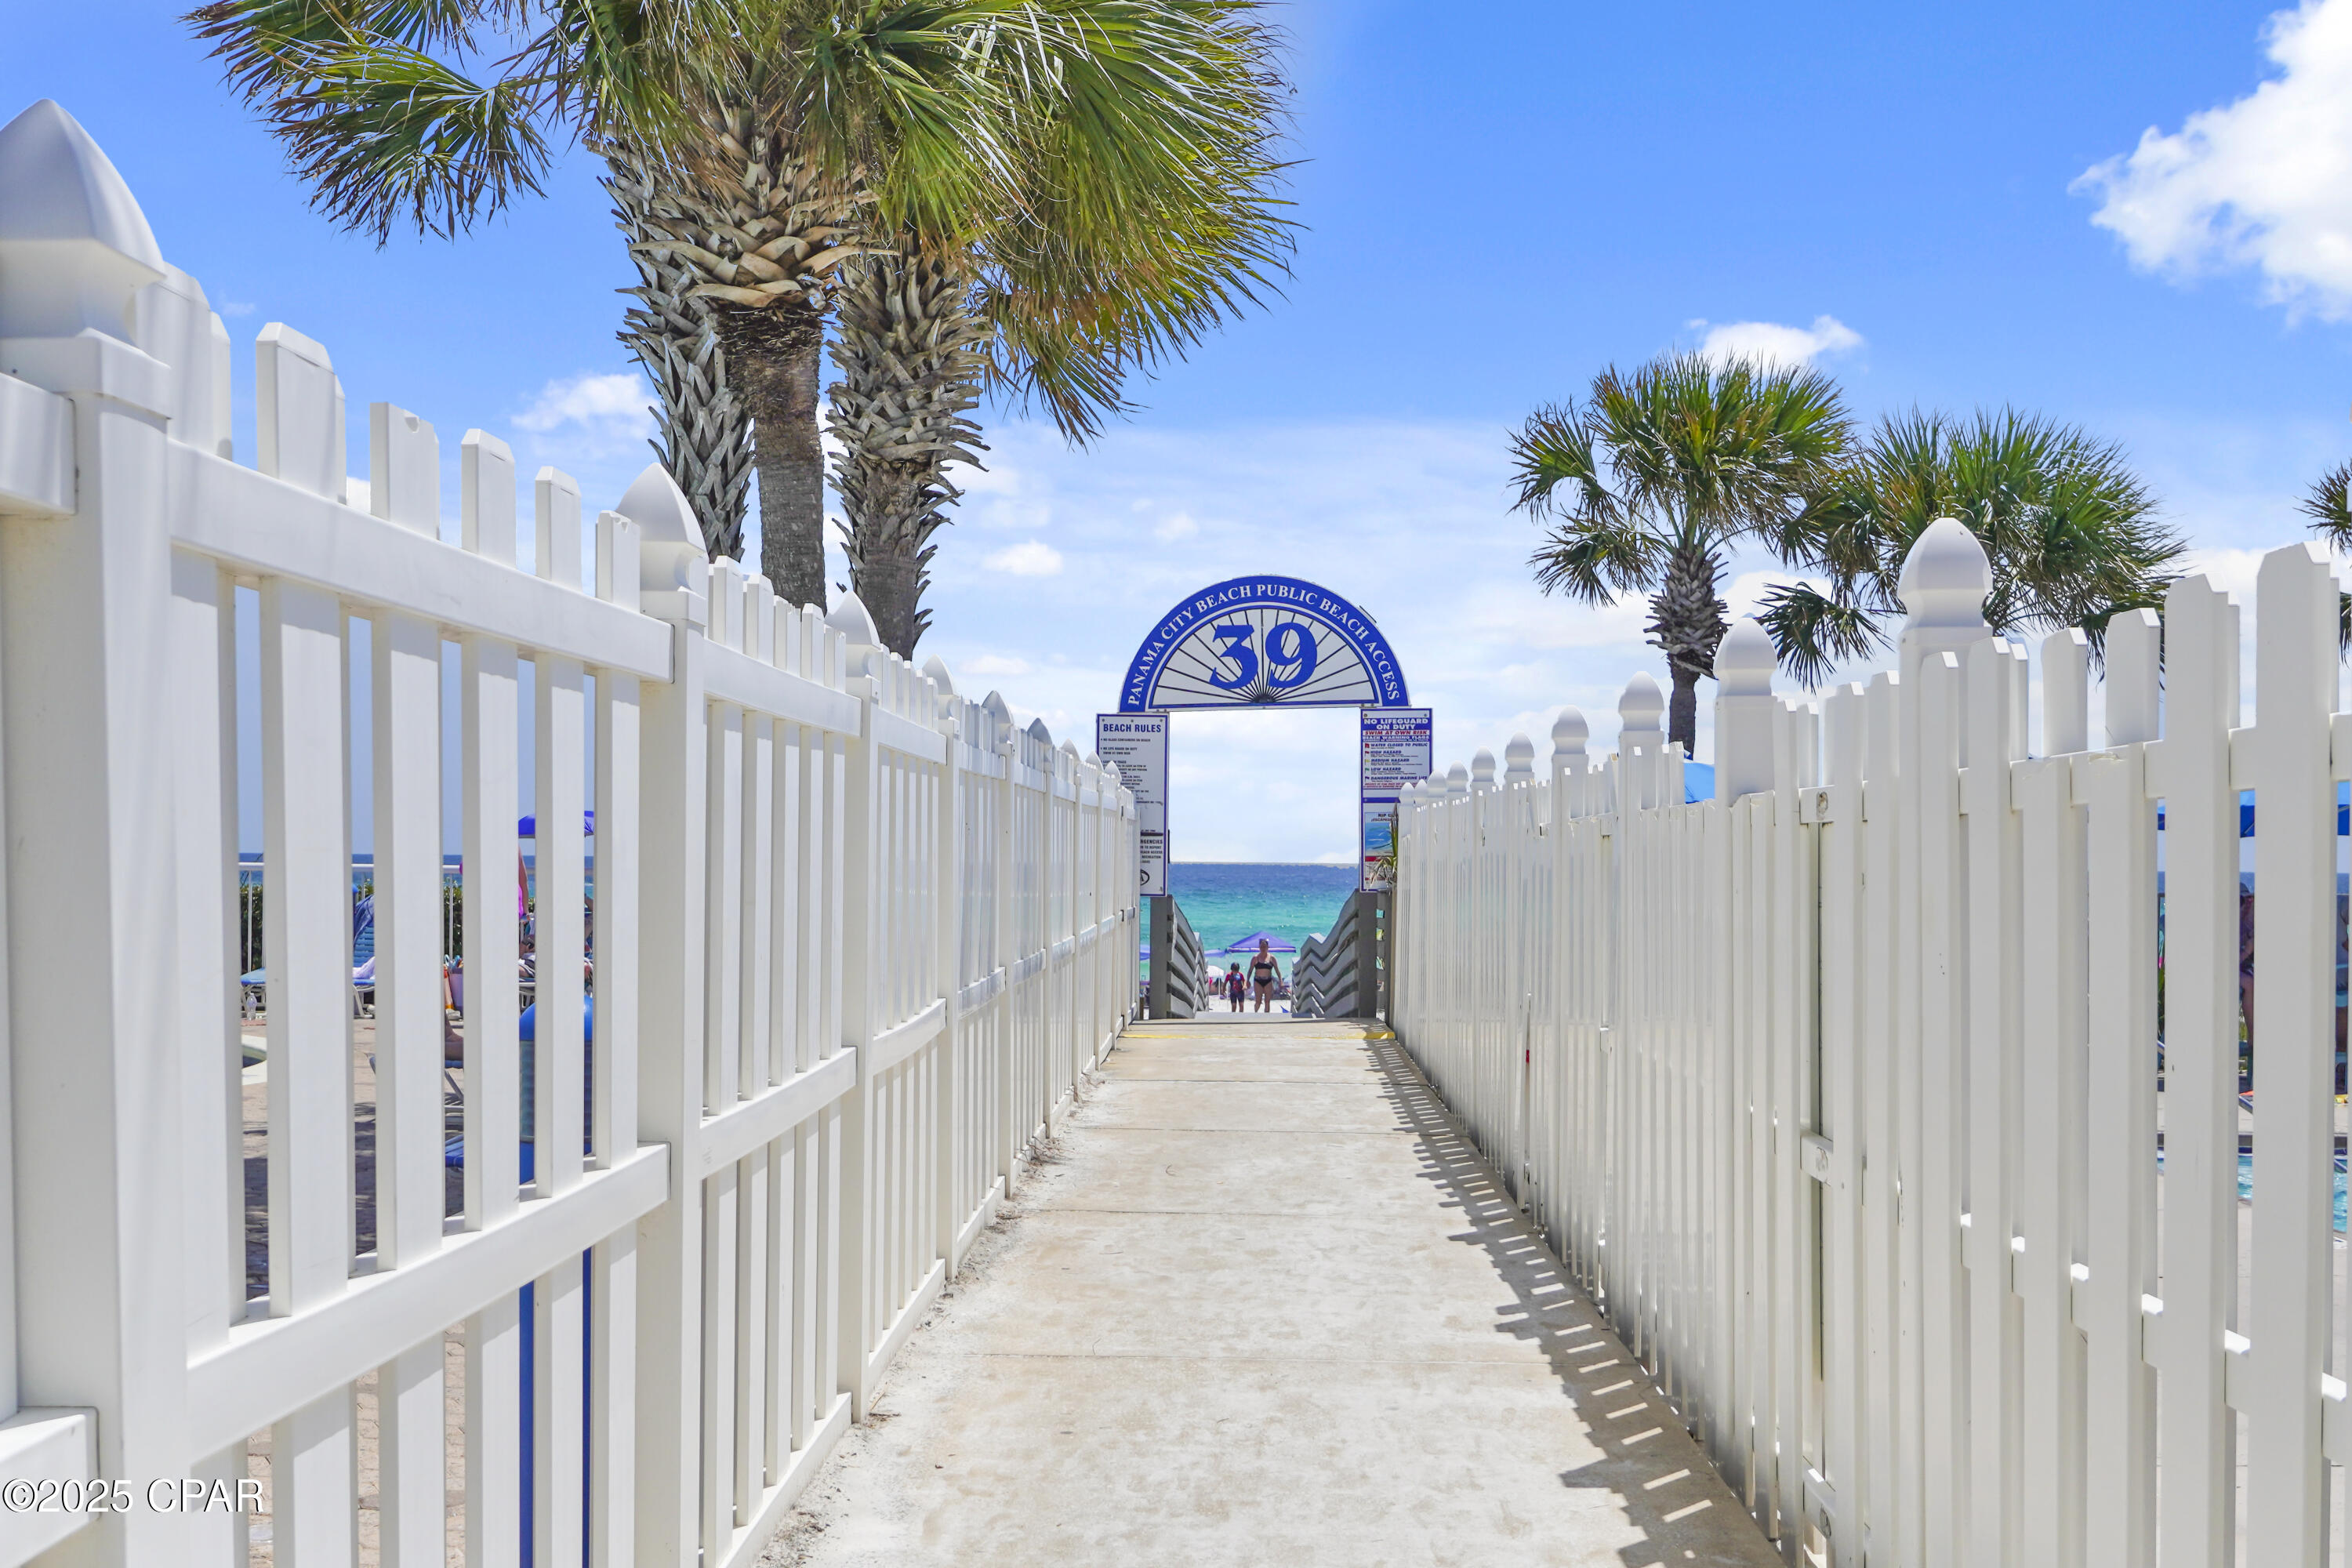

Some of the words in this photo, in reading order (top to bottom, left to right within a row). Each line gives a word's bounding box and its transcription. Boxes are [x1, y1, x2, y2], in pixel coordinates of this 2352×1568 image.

[1127, 640, 1163, 706] PANAMA
[1162, 606, 1195, 641] CITY
[1196, 585, 1251, 613] BEACH
[1257, 584, 1318, 604] PUBLIC
[1319, 597, 1367, 642] BEACH
[1366, 641, 1400, 700] ACCESS
[1209, 622, 1318, 689] 39
[1103, 724, 1131, 732] BEACH
[1134, 724, 1162, 732] RULES
